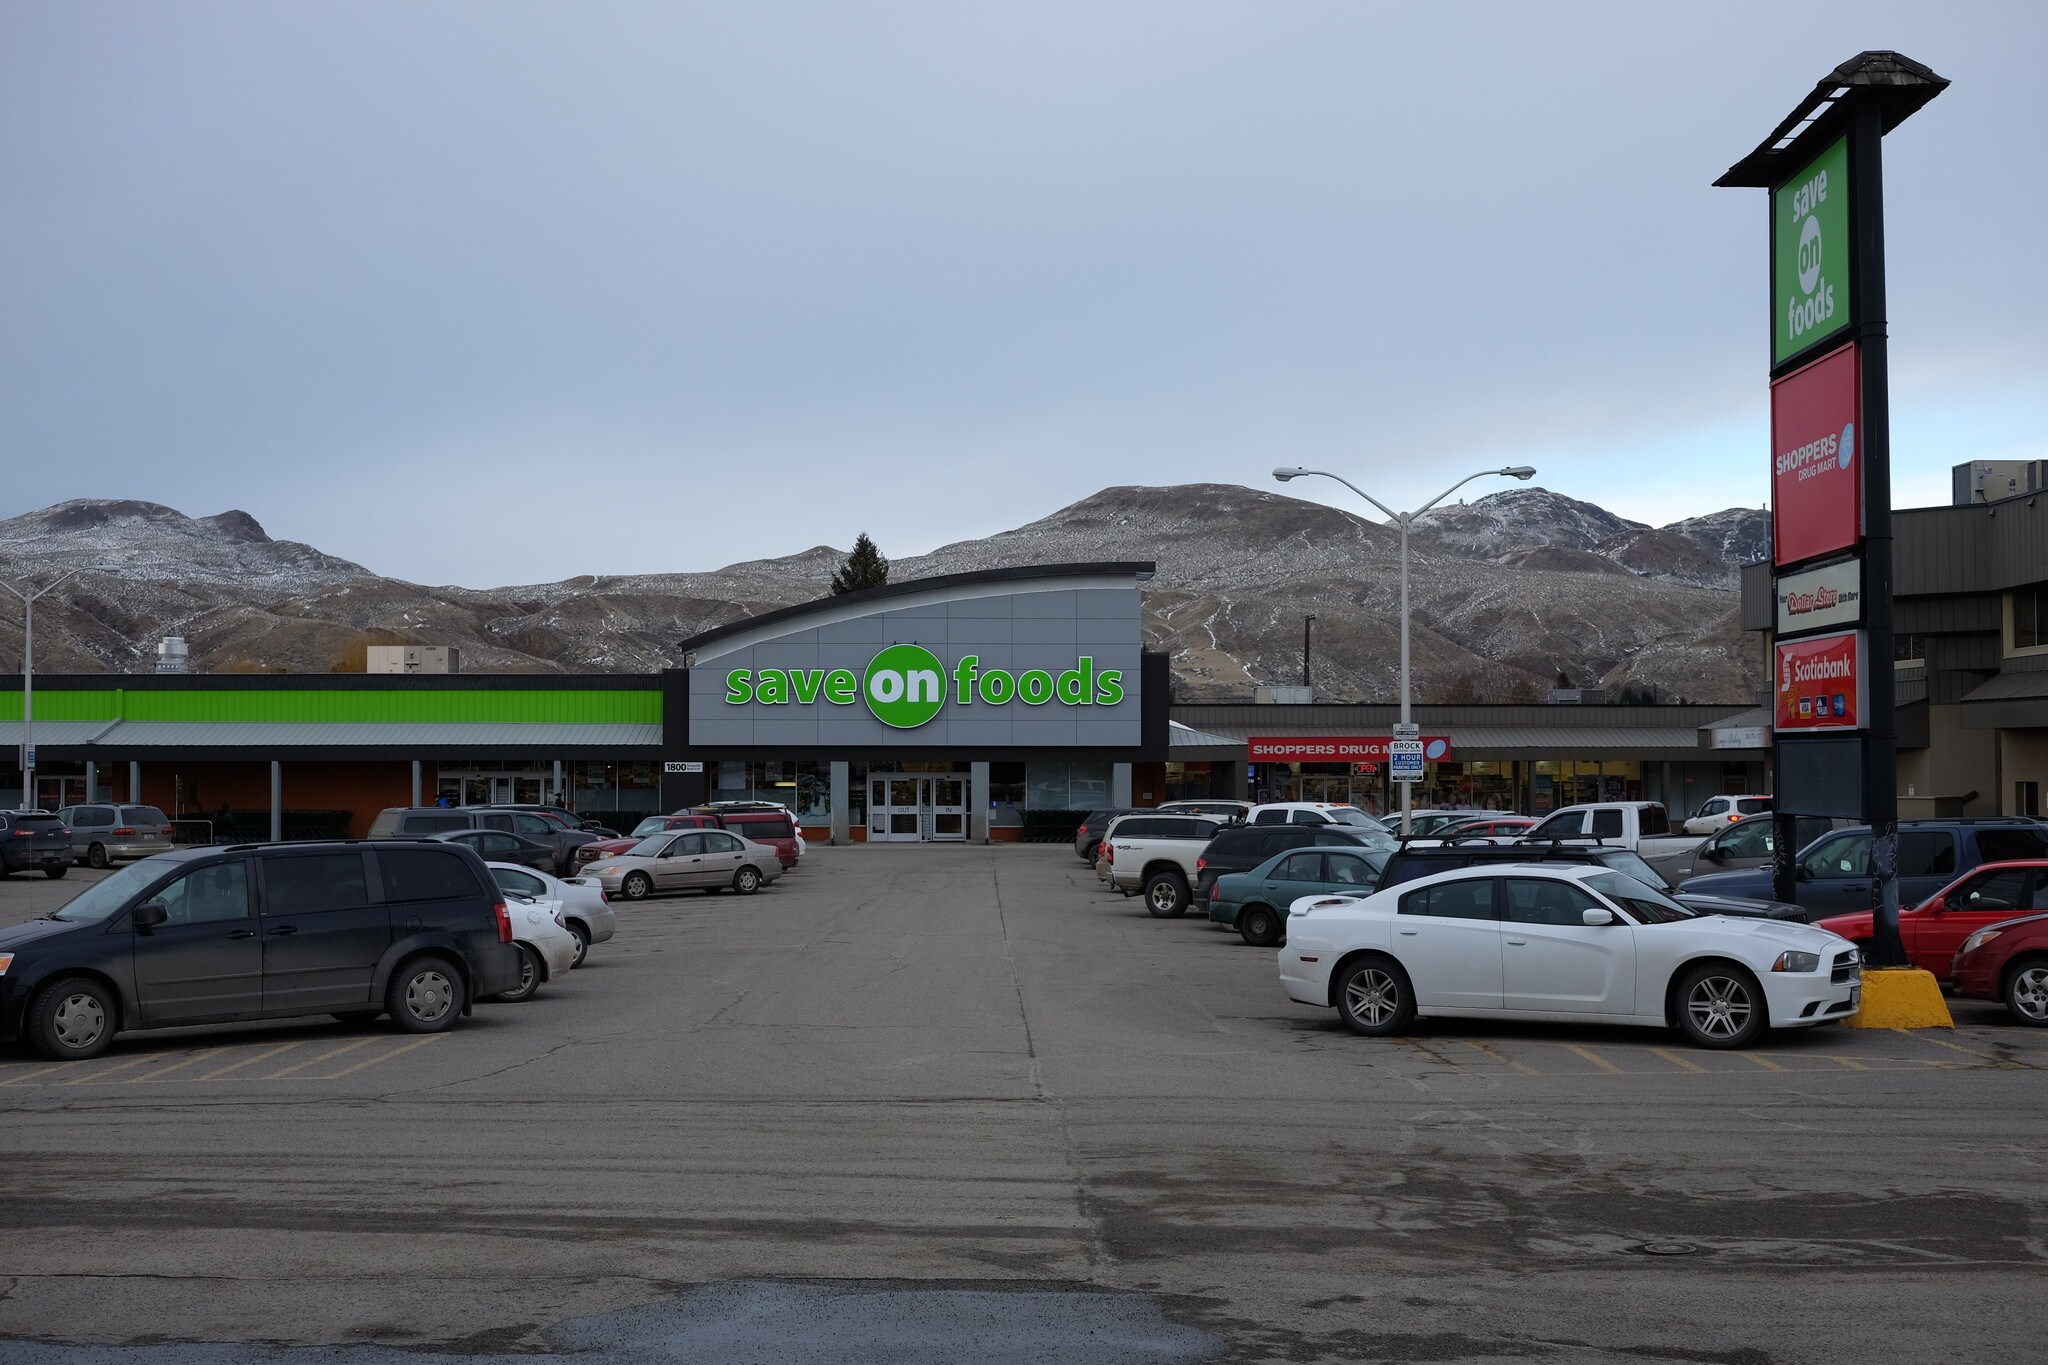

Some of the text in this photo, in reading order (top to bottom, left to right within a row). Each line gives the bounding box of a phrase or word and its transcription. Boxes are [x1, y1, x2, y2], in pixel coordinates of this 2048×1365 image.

[1793, 169, 1827, 223] save
[1800, 235, 1820, 275] on
[1788, 277, 1834, 340] foods
[1776, 433, 1837, 475] SHOPPERS
[1798, 457, 1837, 481] DRUG MART
[1788, 592, 1814, 615] Dollar
[1813, 586, 1838, 611] Store
[725, 655, 1124, 706] save on foods
[1795, 653, 1851, 682] Scotiabank
[1253, 745, 1336, 755] SHOPPERS
[1339, 745, 1380, 755] DRUG
[1393, 742, 1421, 750] BROCK
[666, 763, 687, 772] 1800
[1356, 764, 1375, 773] OPEN
